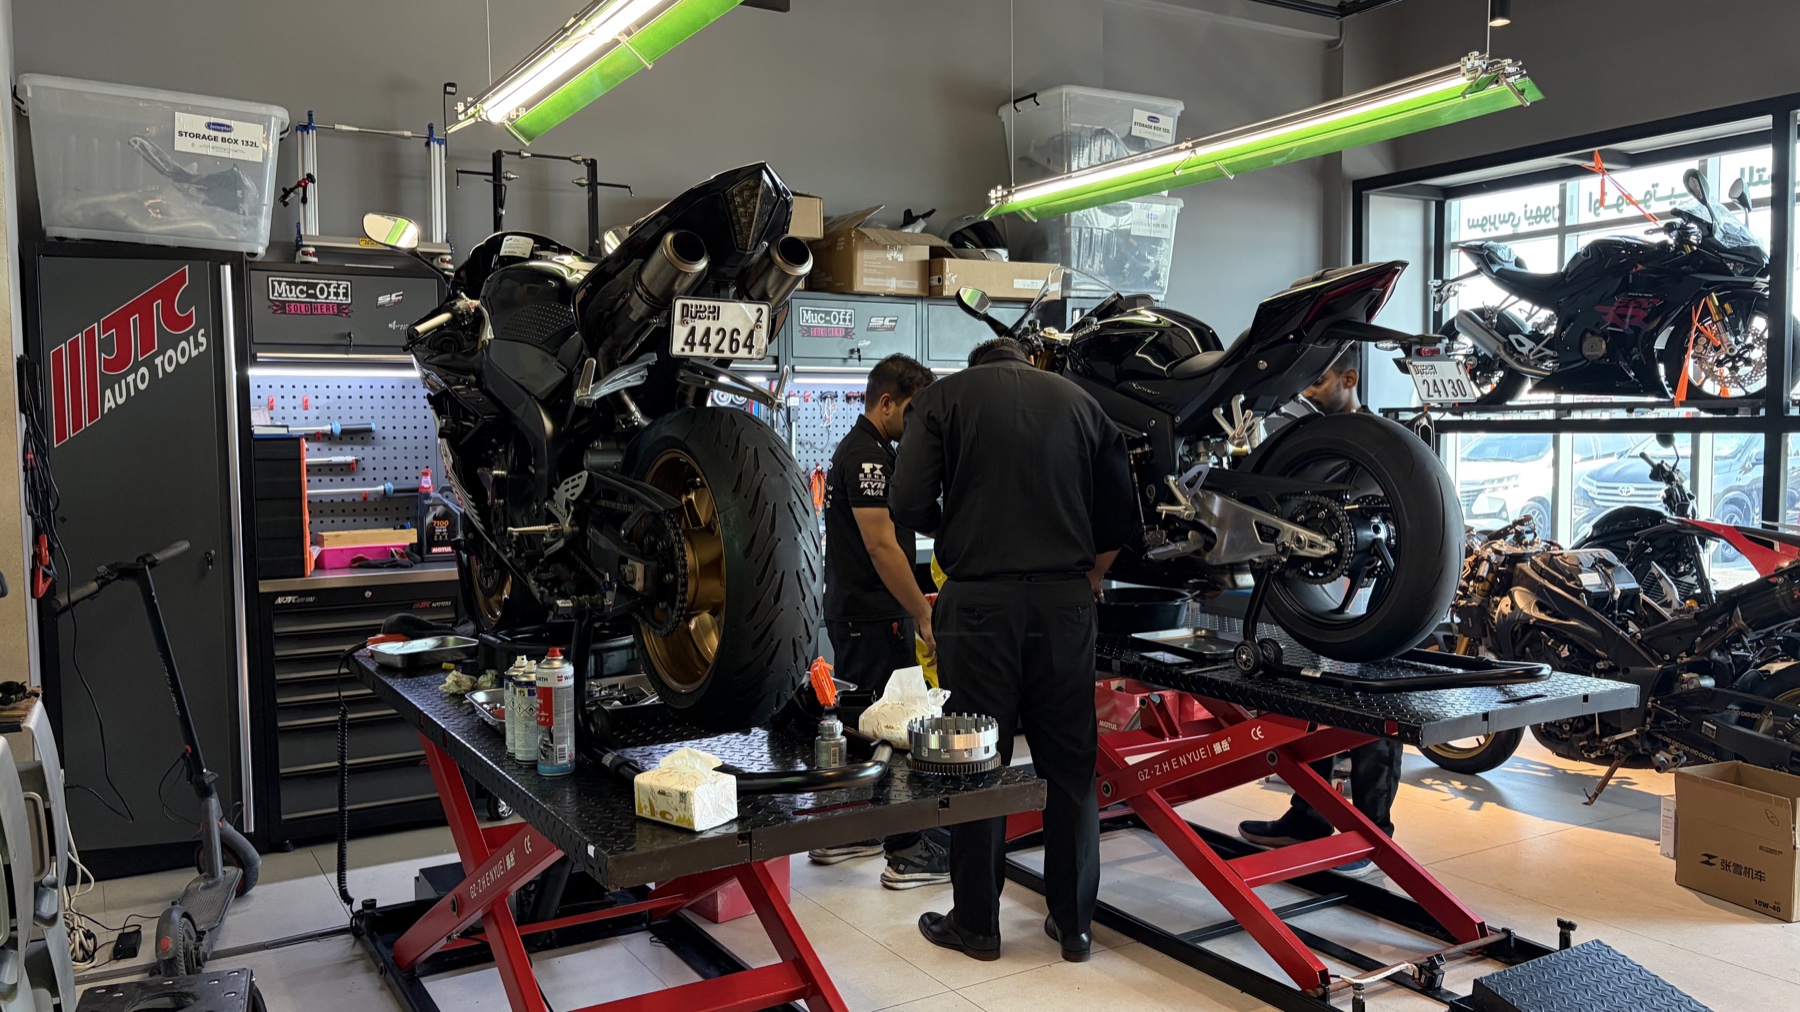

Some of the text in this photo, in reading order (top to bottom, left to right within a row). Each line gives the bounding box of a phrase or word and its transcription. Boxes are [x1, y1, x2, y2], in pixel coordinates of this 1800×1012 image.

[1133, 121, 1153, 130] STORAGE
[177, 130, 219, 142] STORAGE
[220, 136, 239, 145] BOX
[241, 139, 259, 148] 132L
[272, 281, 348, 301] Muc-Off
[377, 291, 404, 303] SC
[286, 303, 338, 314] SOLD HERE
[756, 307, 764, 323] 2
[802, 310, 852, 326] Muc-Off
[869, 317, 898, 326] SC
[811, 327, 845, 336] SOLD HERE
[683, 325, 755, 355] 44264
[103, 328, 208, 415] AUTO TOOLS
[1422, 378, 1468, 398] 24130
[860, 481, 886, 489] KYB
[1099, 720, 1118, 731] MOTUL
[1251, 725, 1265, 741] CE
[1720, 858, 1766, 882] 张雪机车
[1753, 898, 1781, 913] 10W-40
